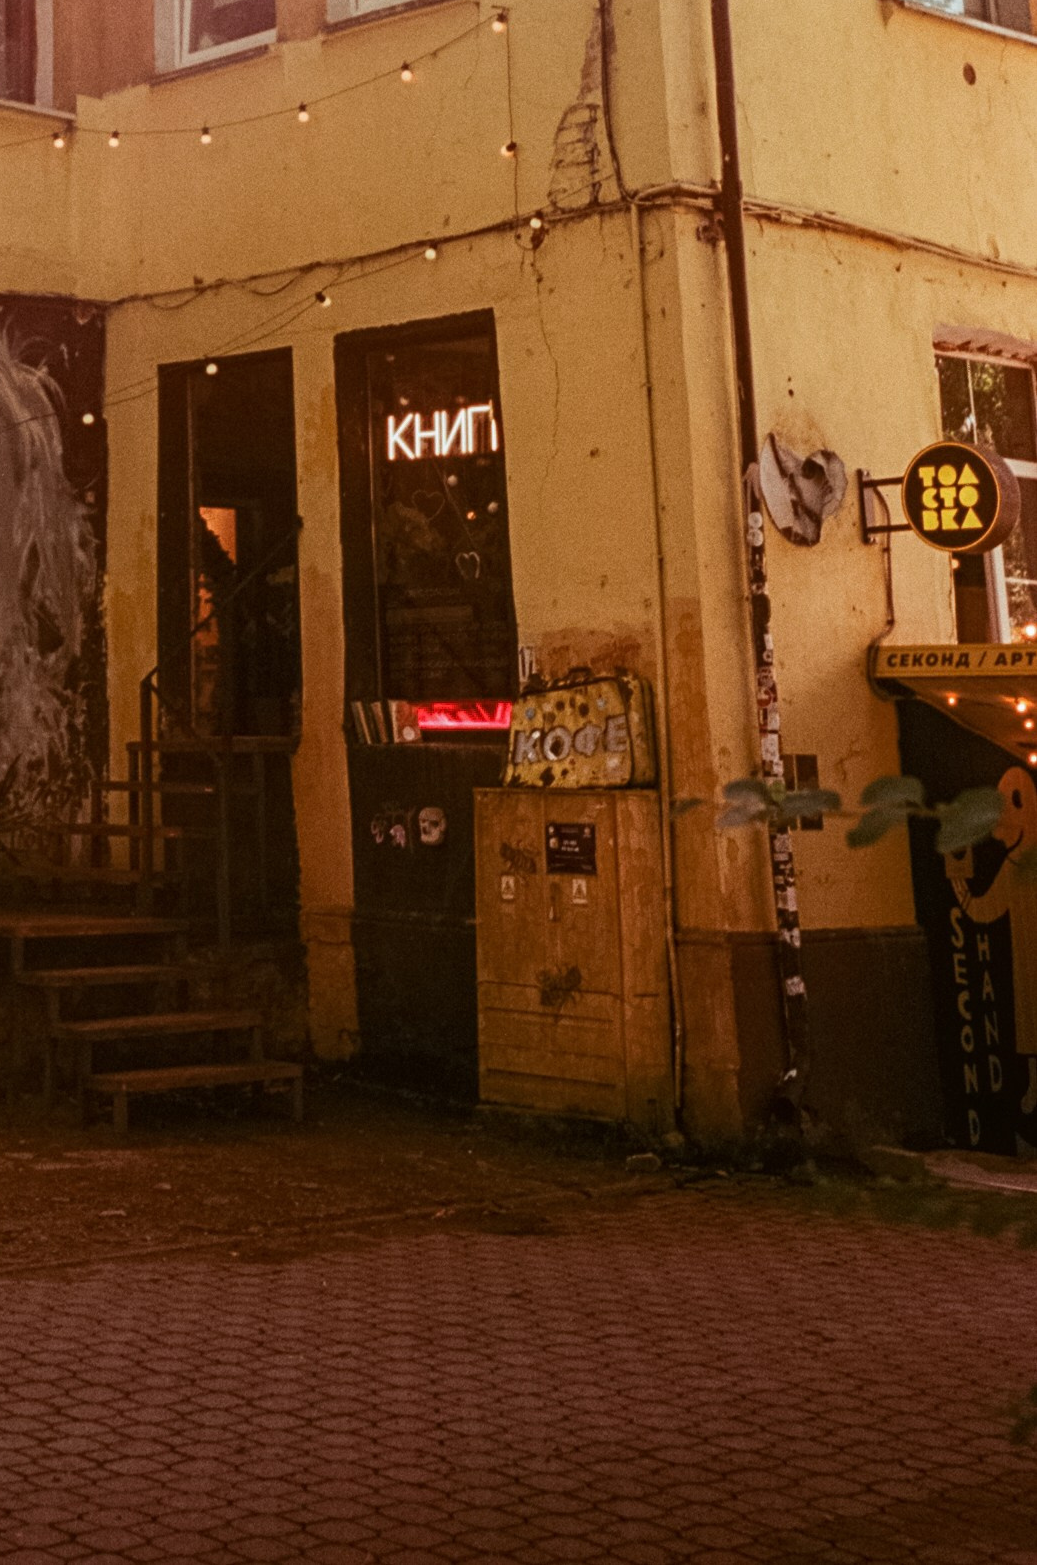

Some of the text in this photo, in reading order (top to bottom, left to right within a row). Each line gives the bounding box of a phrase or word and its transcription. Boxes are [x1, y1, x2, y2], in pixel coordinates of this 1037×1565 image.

[922, 485, 979, 509] СТО
[886, 652, 970, 669] СЕКОНД
[994, 651, 1037, 666] АРТ
[513, 715, 628, 764] КОФЕ
[949, 907, 980, 1146] SECOND
[976, 933, 1003, 1093] HAND
